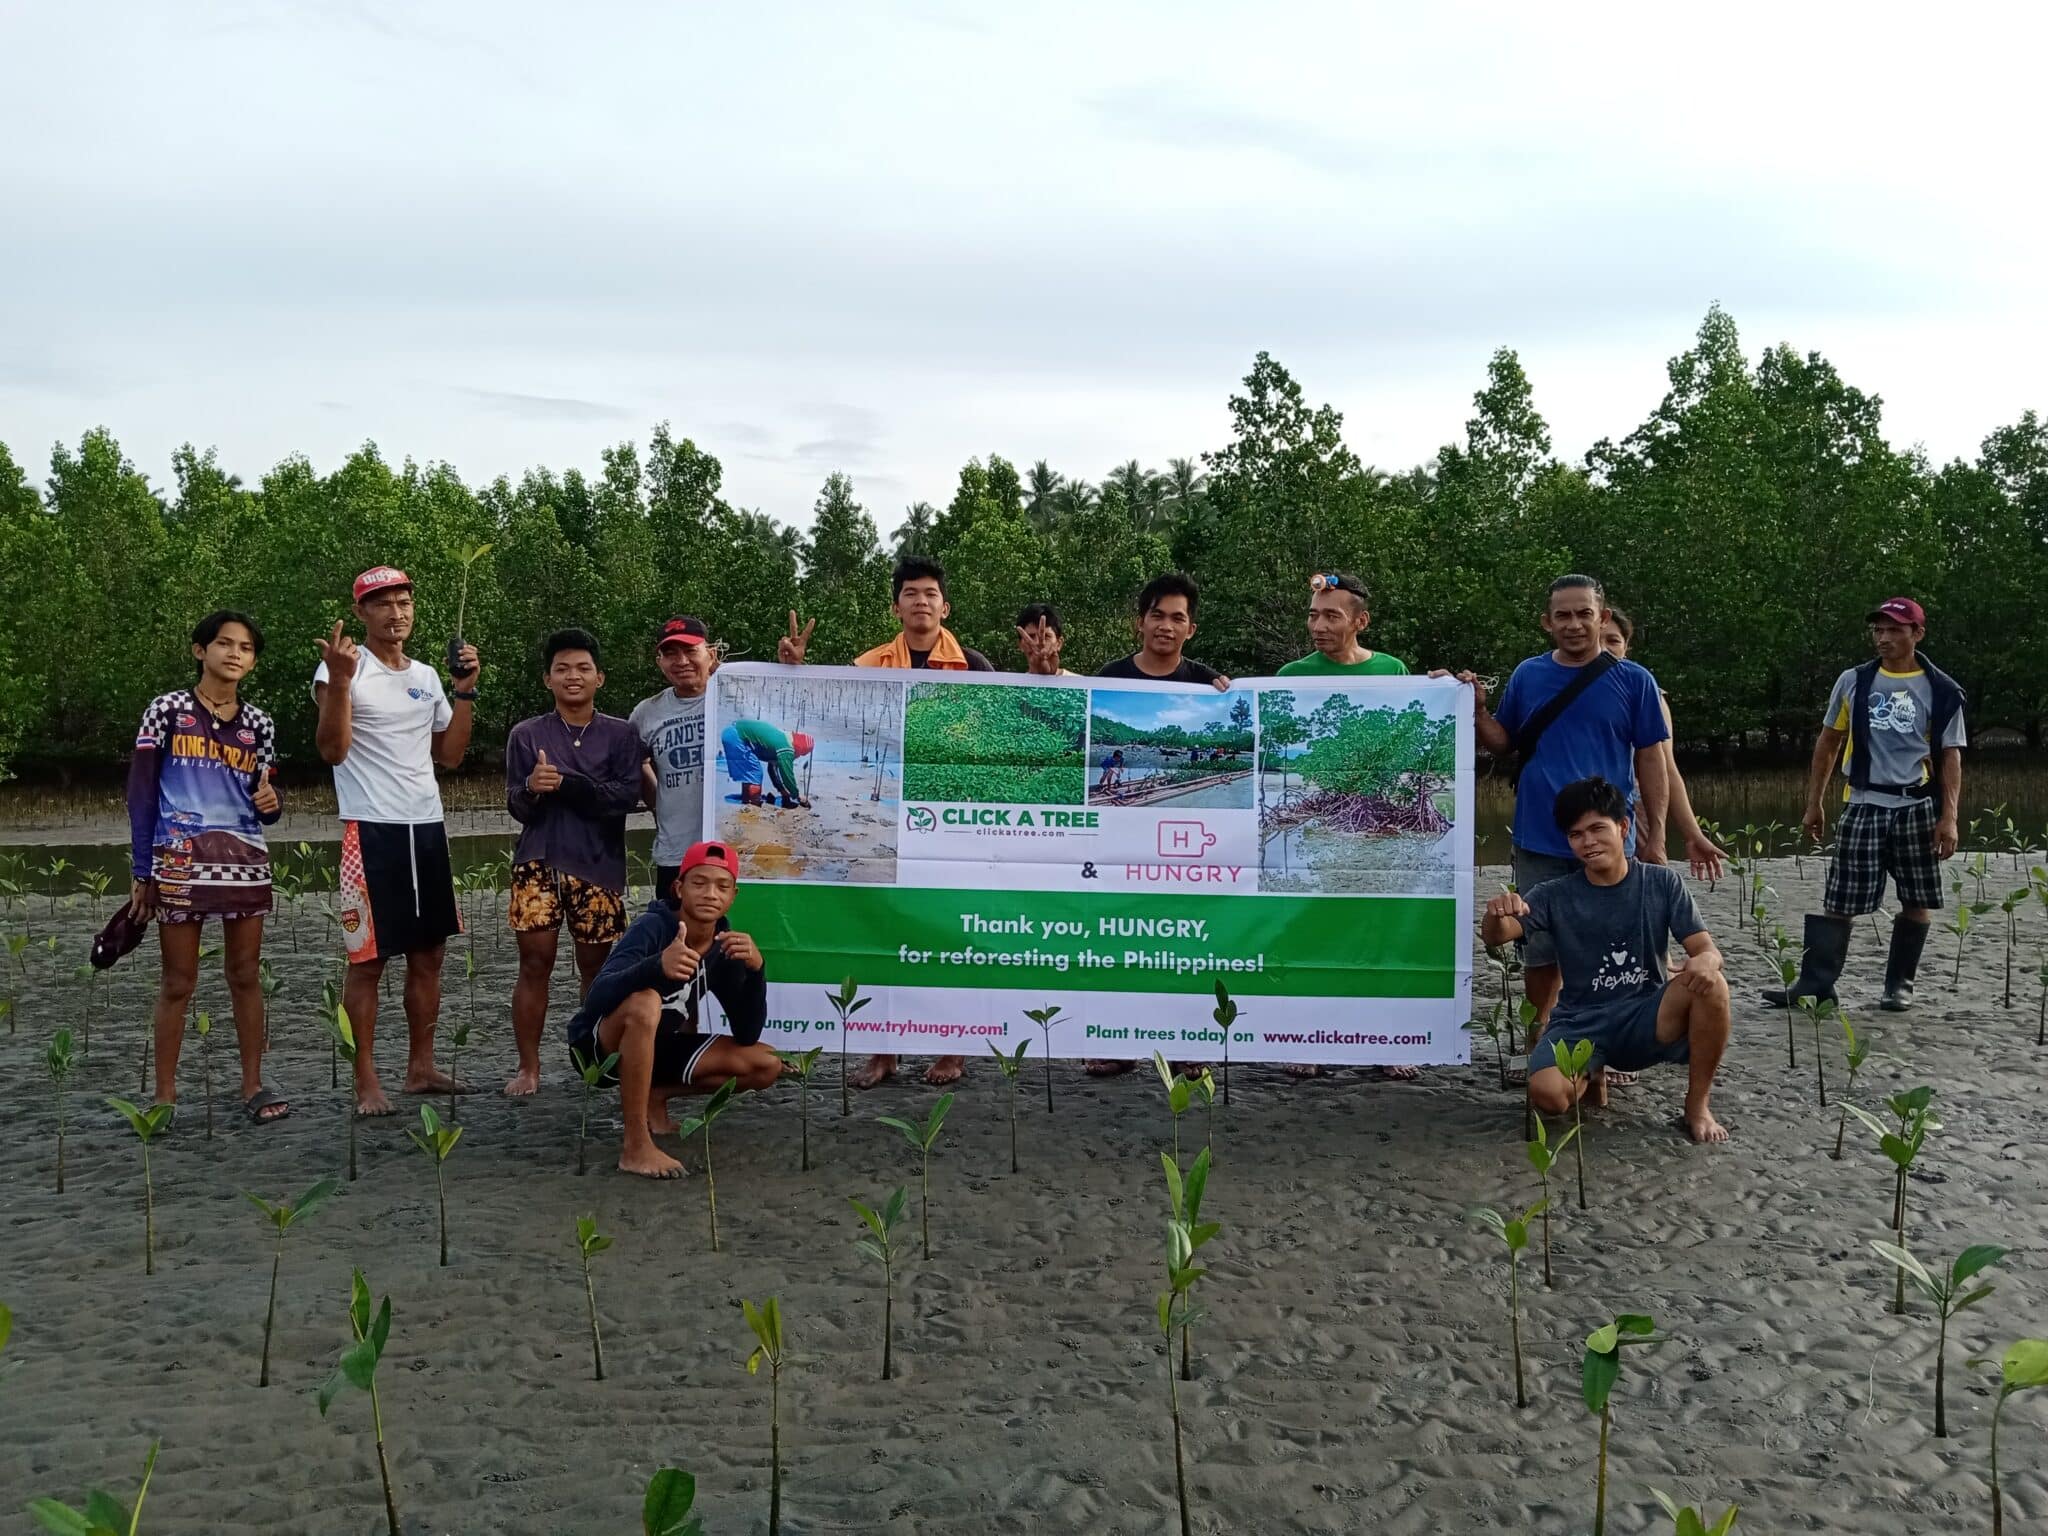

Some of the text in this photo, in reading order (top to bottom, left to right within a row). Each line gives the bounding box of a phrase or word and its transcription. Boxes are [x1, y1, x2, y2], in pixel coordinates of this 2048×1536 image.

[172, 734, 206, 759] KING
[223, 744, 257, 774] DRAG
[665, 770, 693, 789] GIFT
[942, 808, 1099, 828] CLICK A TREE
[976, 828, 1065, 838] clickatree.com
[1173, 830, 1189, 849] H
[1081, 861, 1098, 879] &
[1126, 863, 1242, 882] HUNGRY
[959, 913, 1209, 941] Thank you, HUNGRY,
[898, 944, 1264, 976] for reforesting the Philippines!
[764, 1018, 1008, 1039] ungry on www.tryhungry.com!
[1086, 1025, 1432, 1046] Plant trees today on www.clickatree.com!
